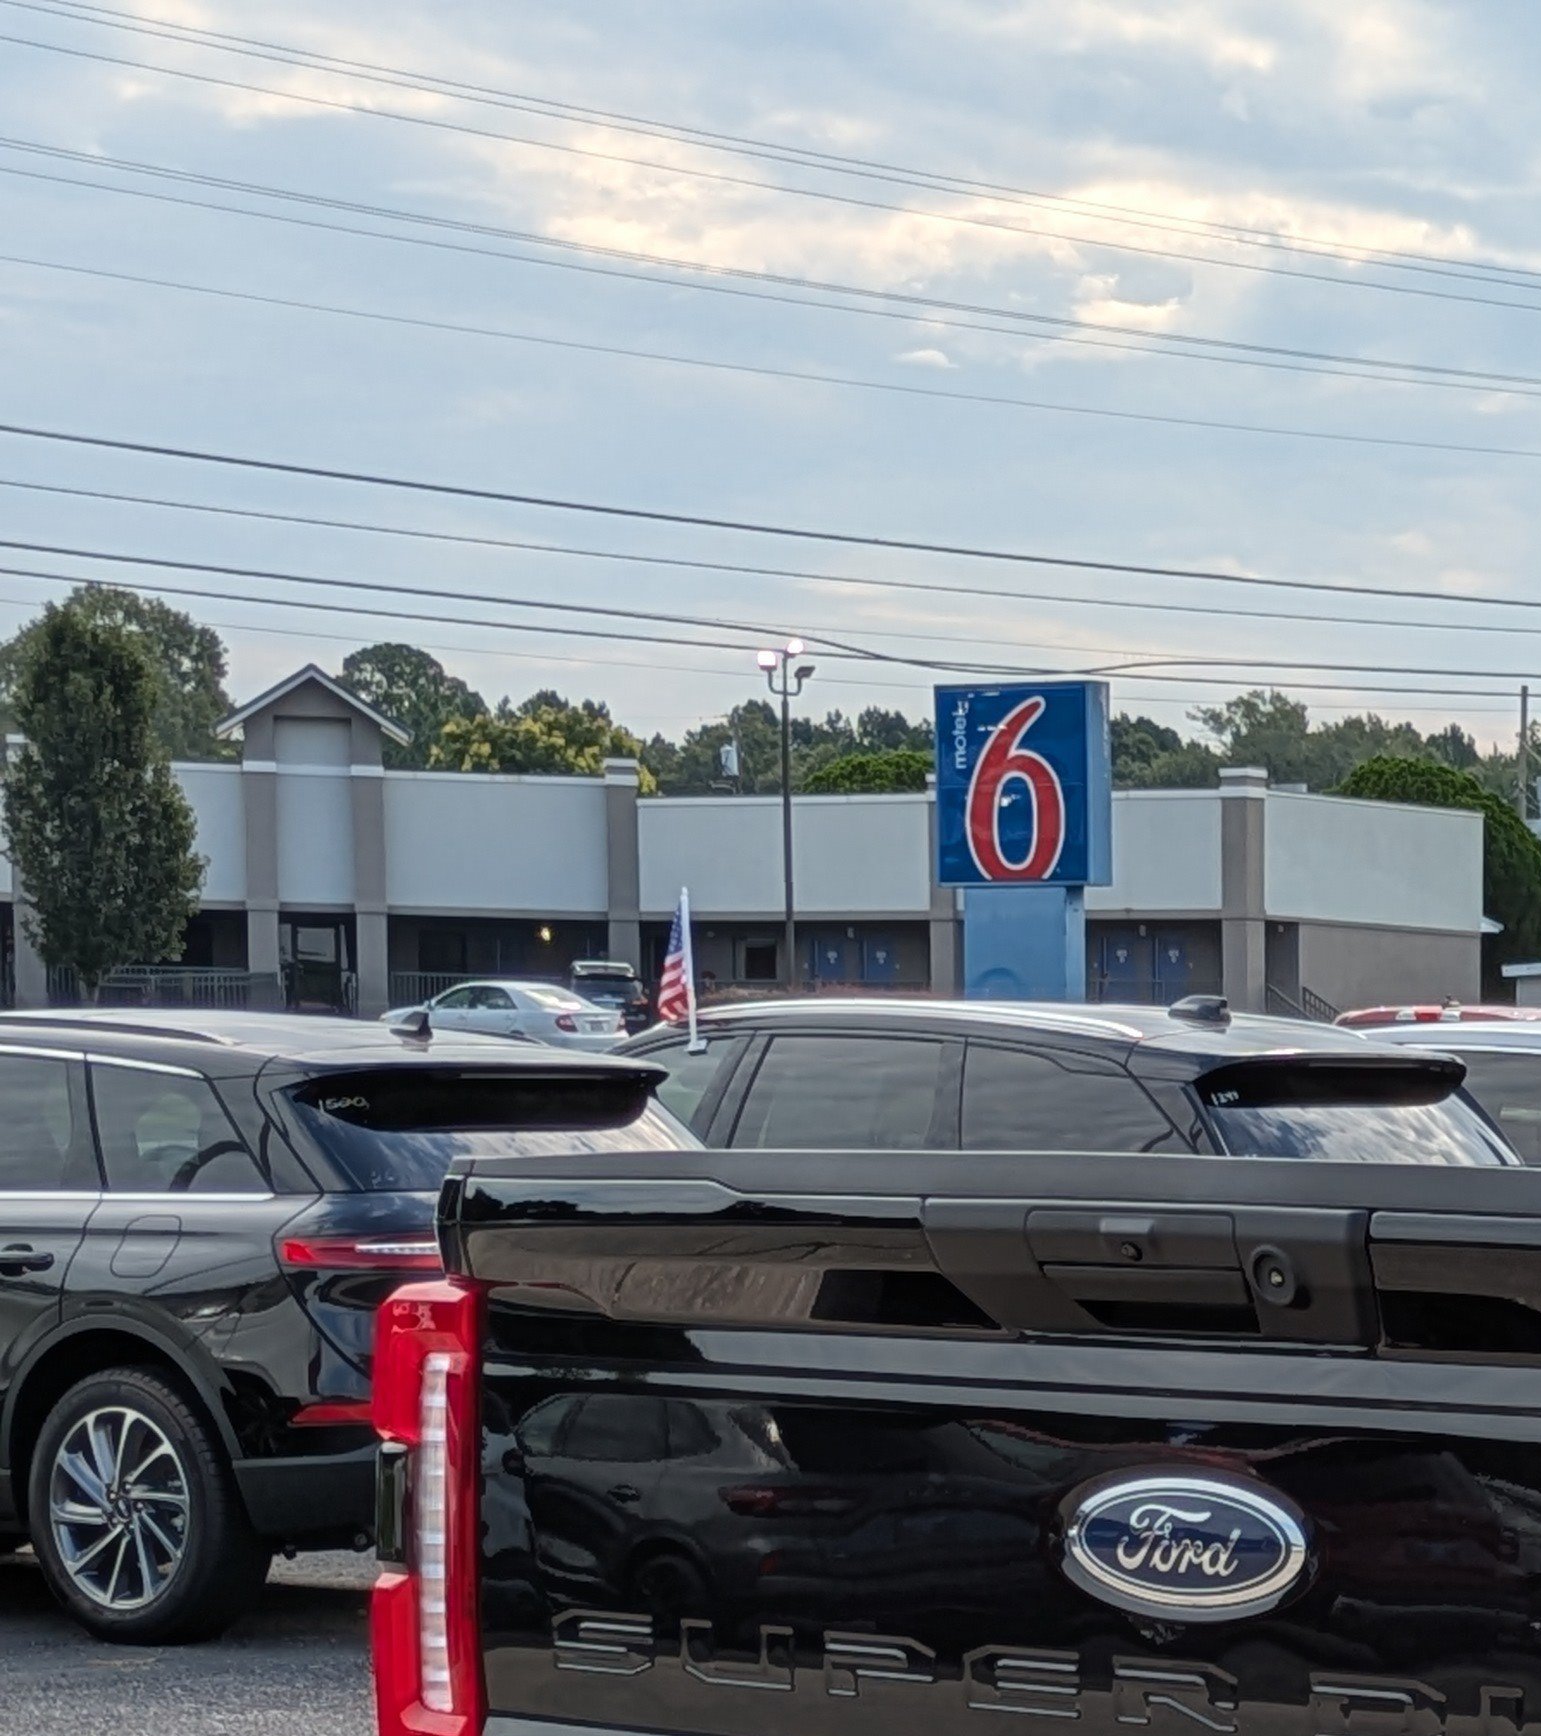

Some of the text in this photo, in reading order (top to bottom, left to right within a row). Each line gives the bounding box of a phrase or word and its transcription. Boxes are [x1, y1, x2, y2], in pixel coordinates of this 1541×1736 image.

[965, 695, 1066, 882] 6
[1116, 1503, 1241, 1578] Ford
[551, 1607, 1239, 1734] SUPER
